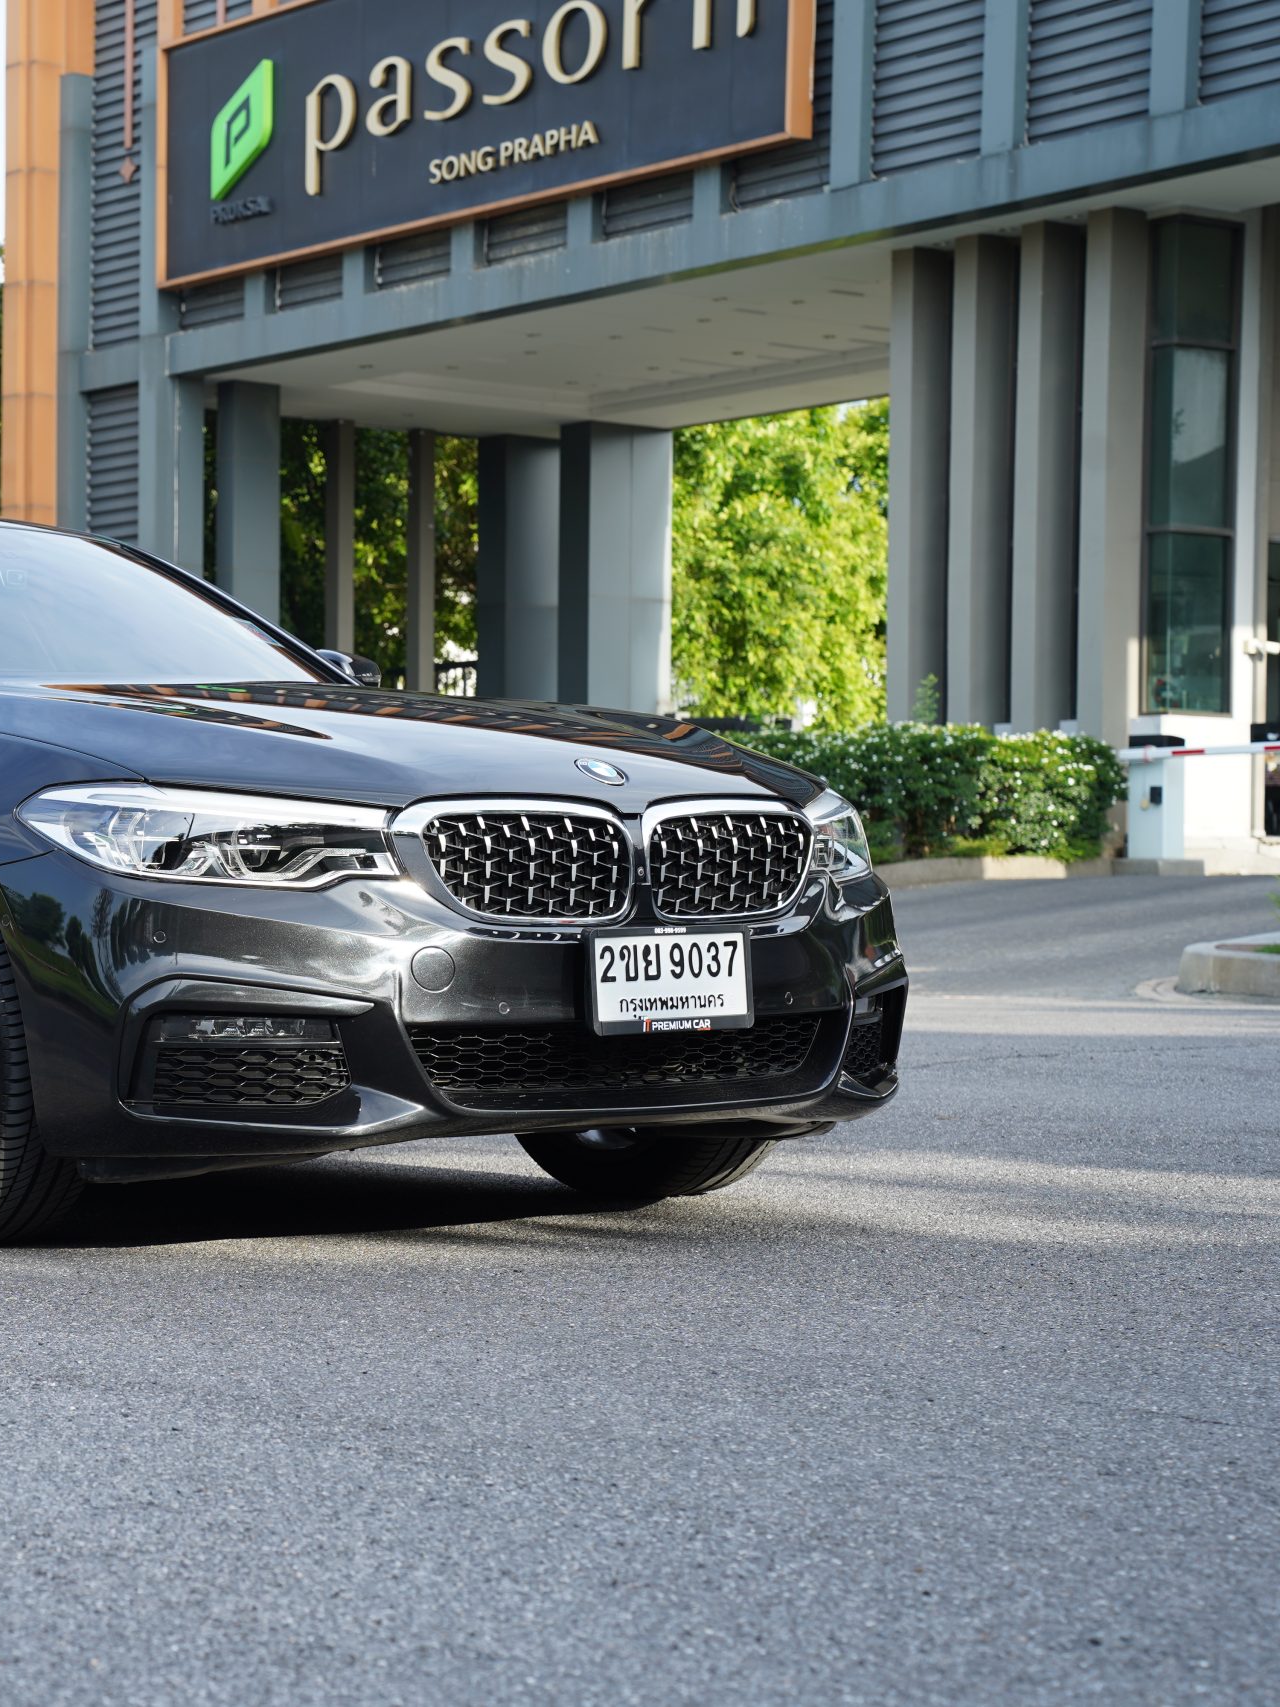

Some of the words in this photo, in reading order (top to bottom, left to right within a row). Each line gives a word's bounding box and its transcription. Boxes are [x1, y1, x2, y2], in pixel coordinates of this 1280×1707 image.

[429, 146, 496, 184] SONG
[499, 120, 599, 167] PRAPHA
[600, 943, 661, 983] 2ขย
[670, 940, 738, 979] 9037
[619, 993, 725, 1020] กรุงเทพมหานคร
[651, 1020, 692, 1031] PREMIUM
[693, 1019, 711, 1029] CAR
